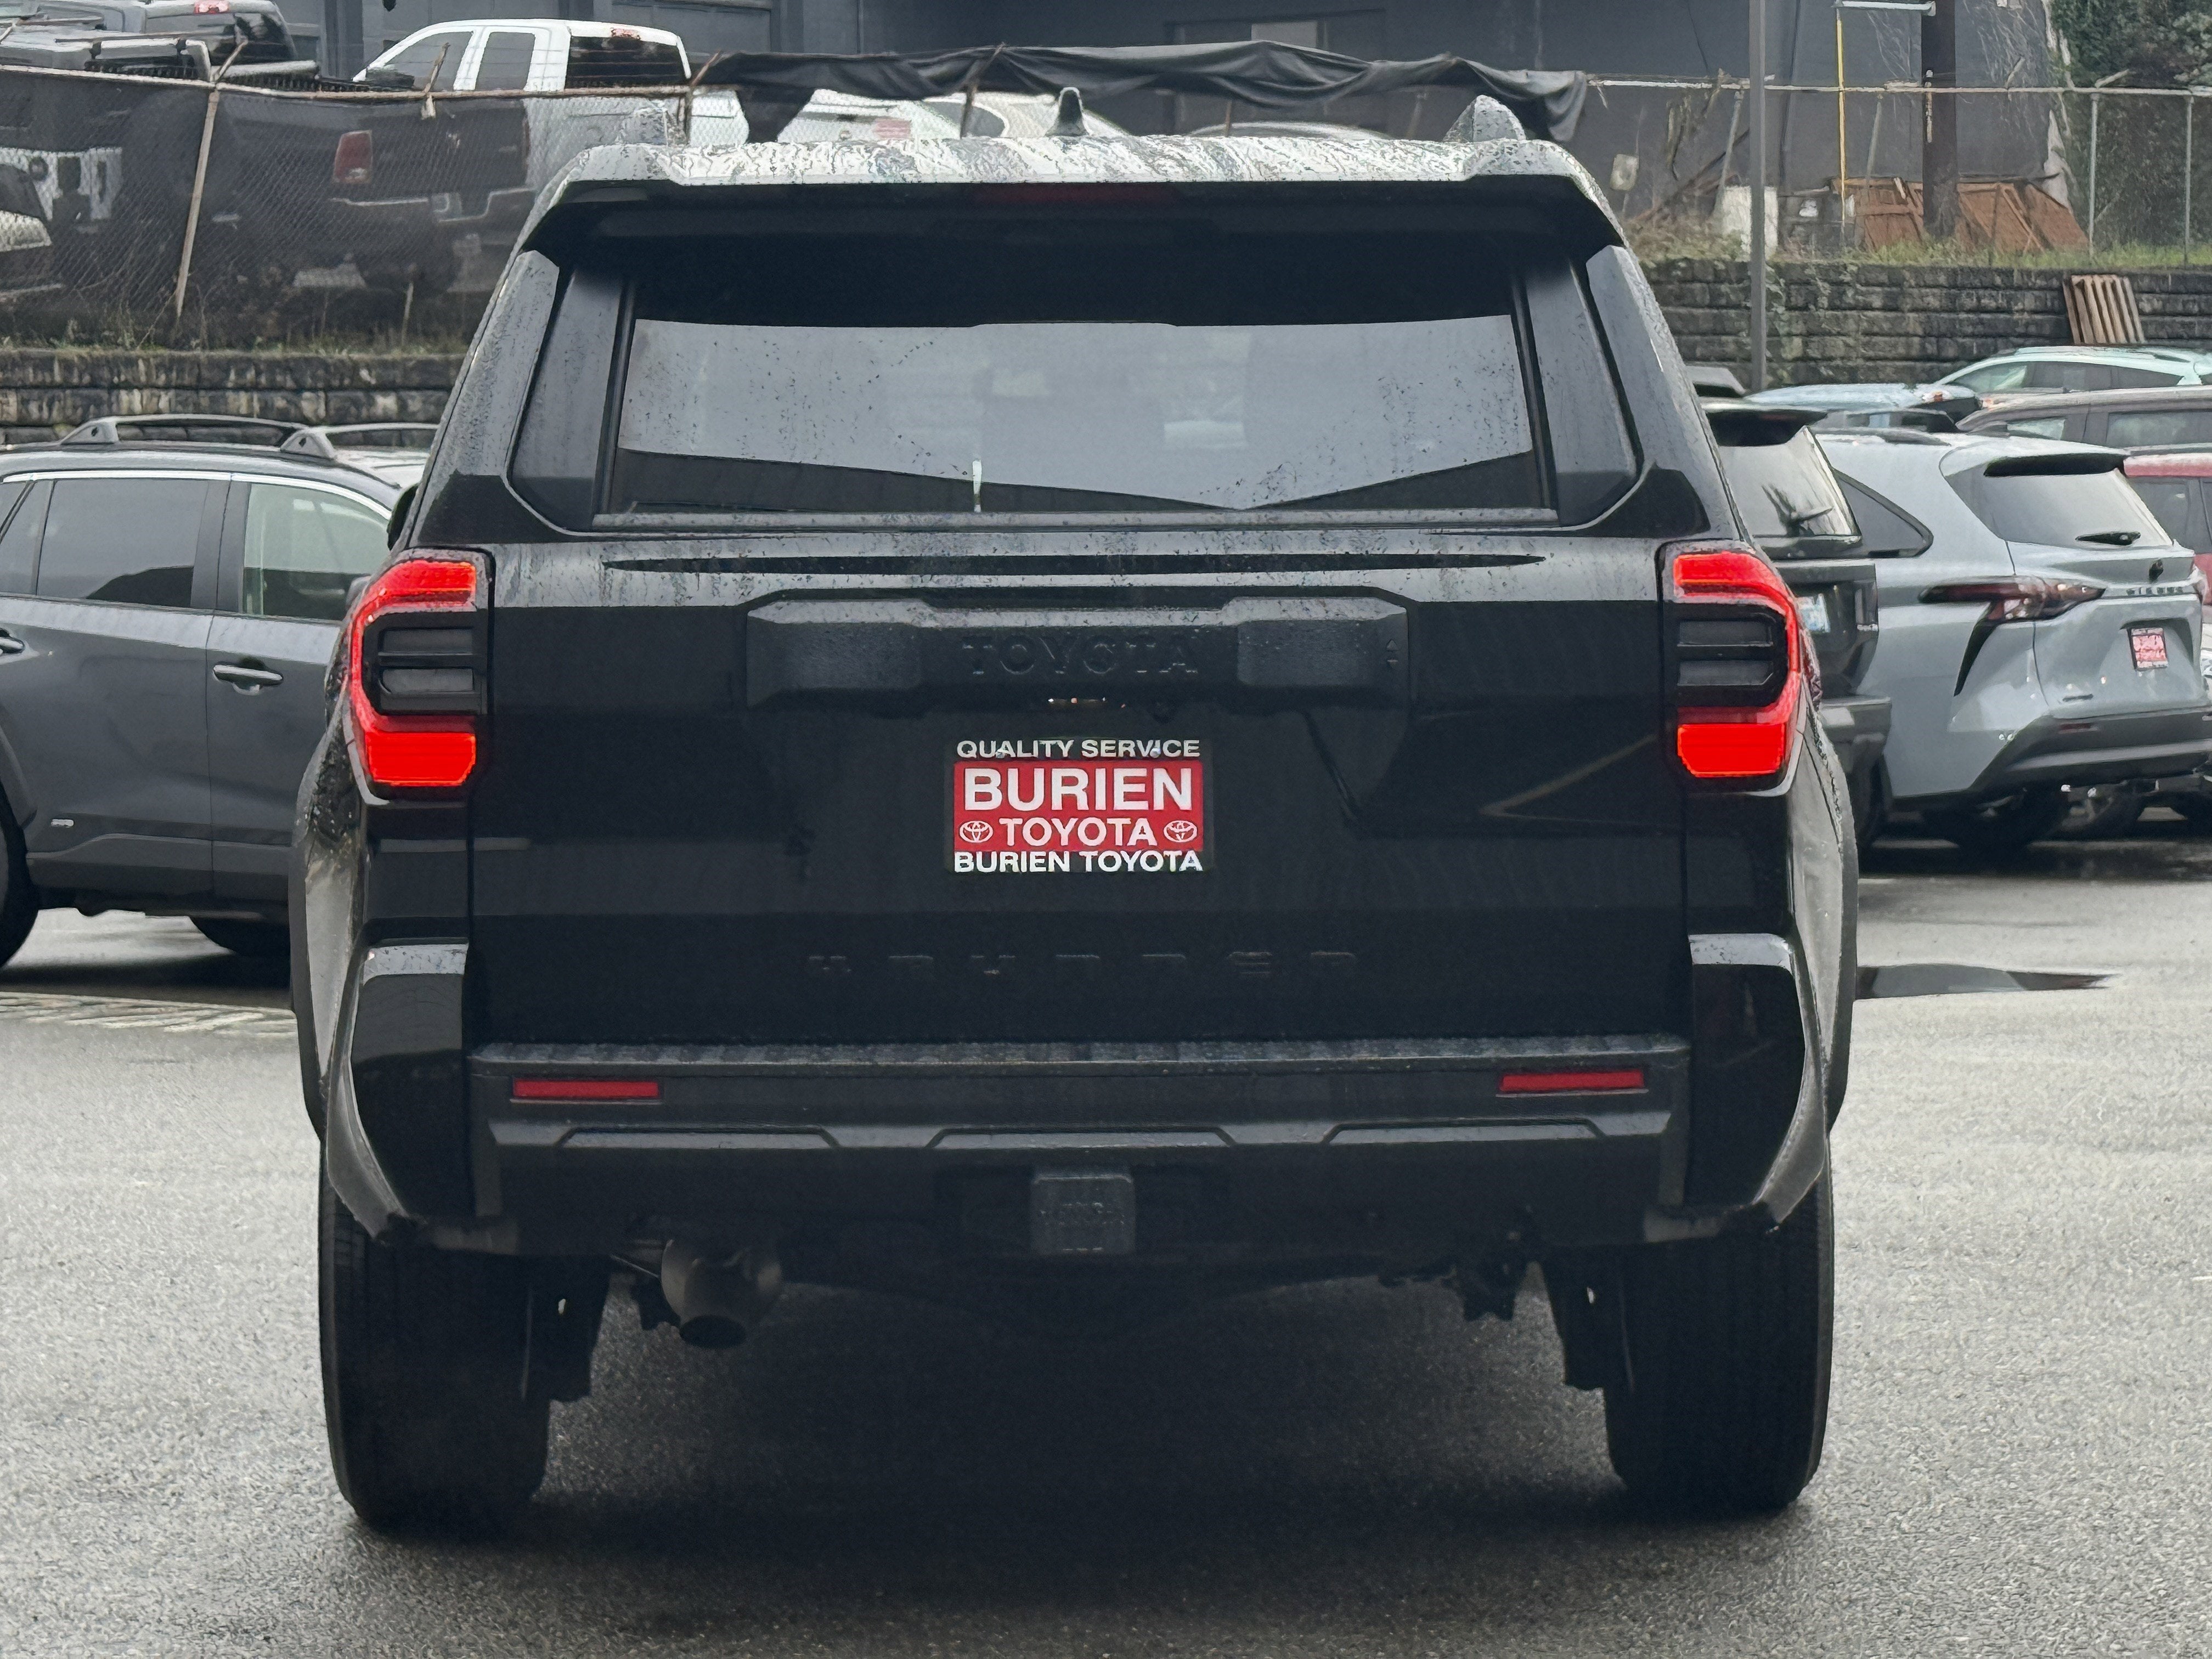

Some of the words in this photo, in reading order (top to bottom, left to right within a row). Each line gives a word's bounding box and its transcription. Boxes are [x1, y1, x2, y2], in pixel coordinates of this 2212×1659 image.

[961, 635, 1199, 675] TOYOTA
[956, 740, 1075, 758] QUALITY
[1081, 740, 1200, 758] SERVICE
[964, 768, 1193, 811] BURIEN
[999, 817, 1158, 847] TOYOTA
[953, 851, 1070, 873] BURIEN
[1078, 851, 1203, 872] TOYOTA
